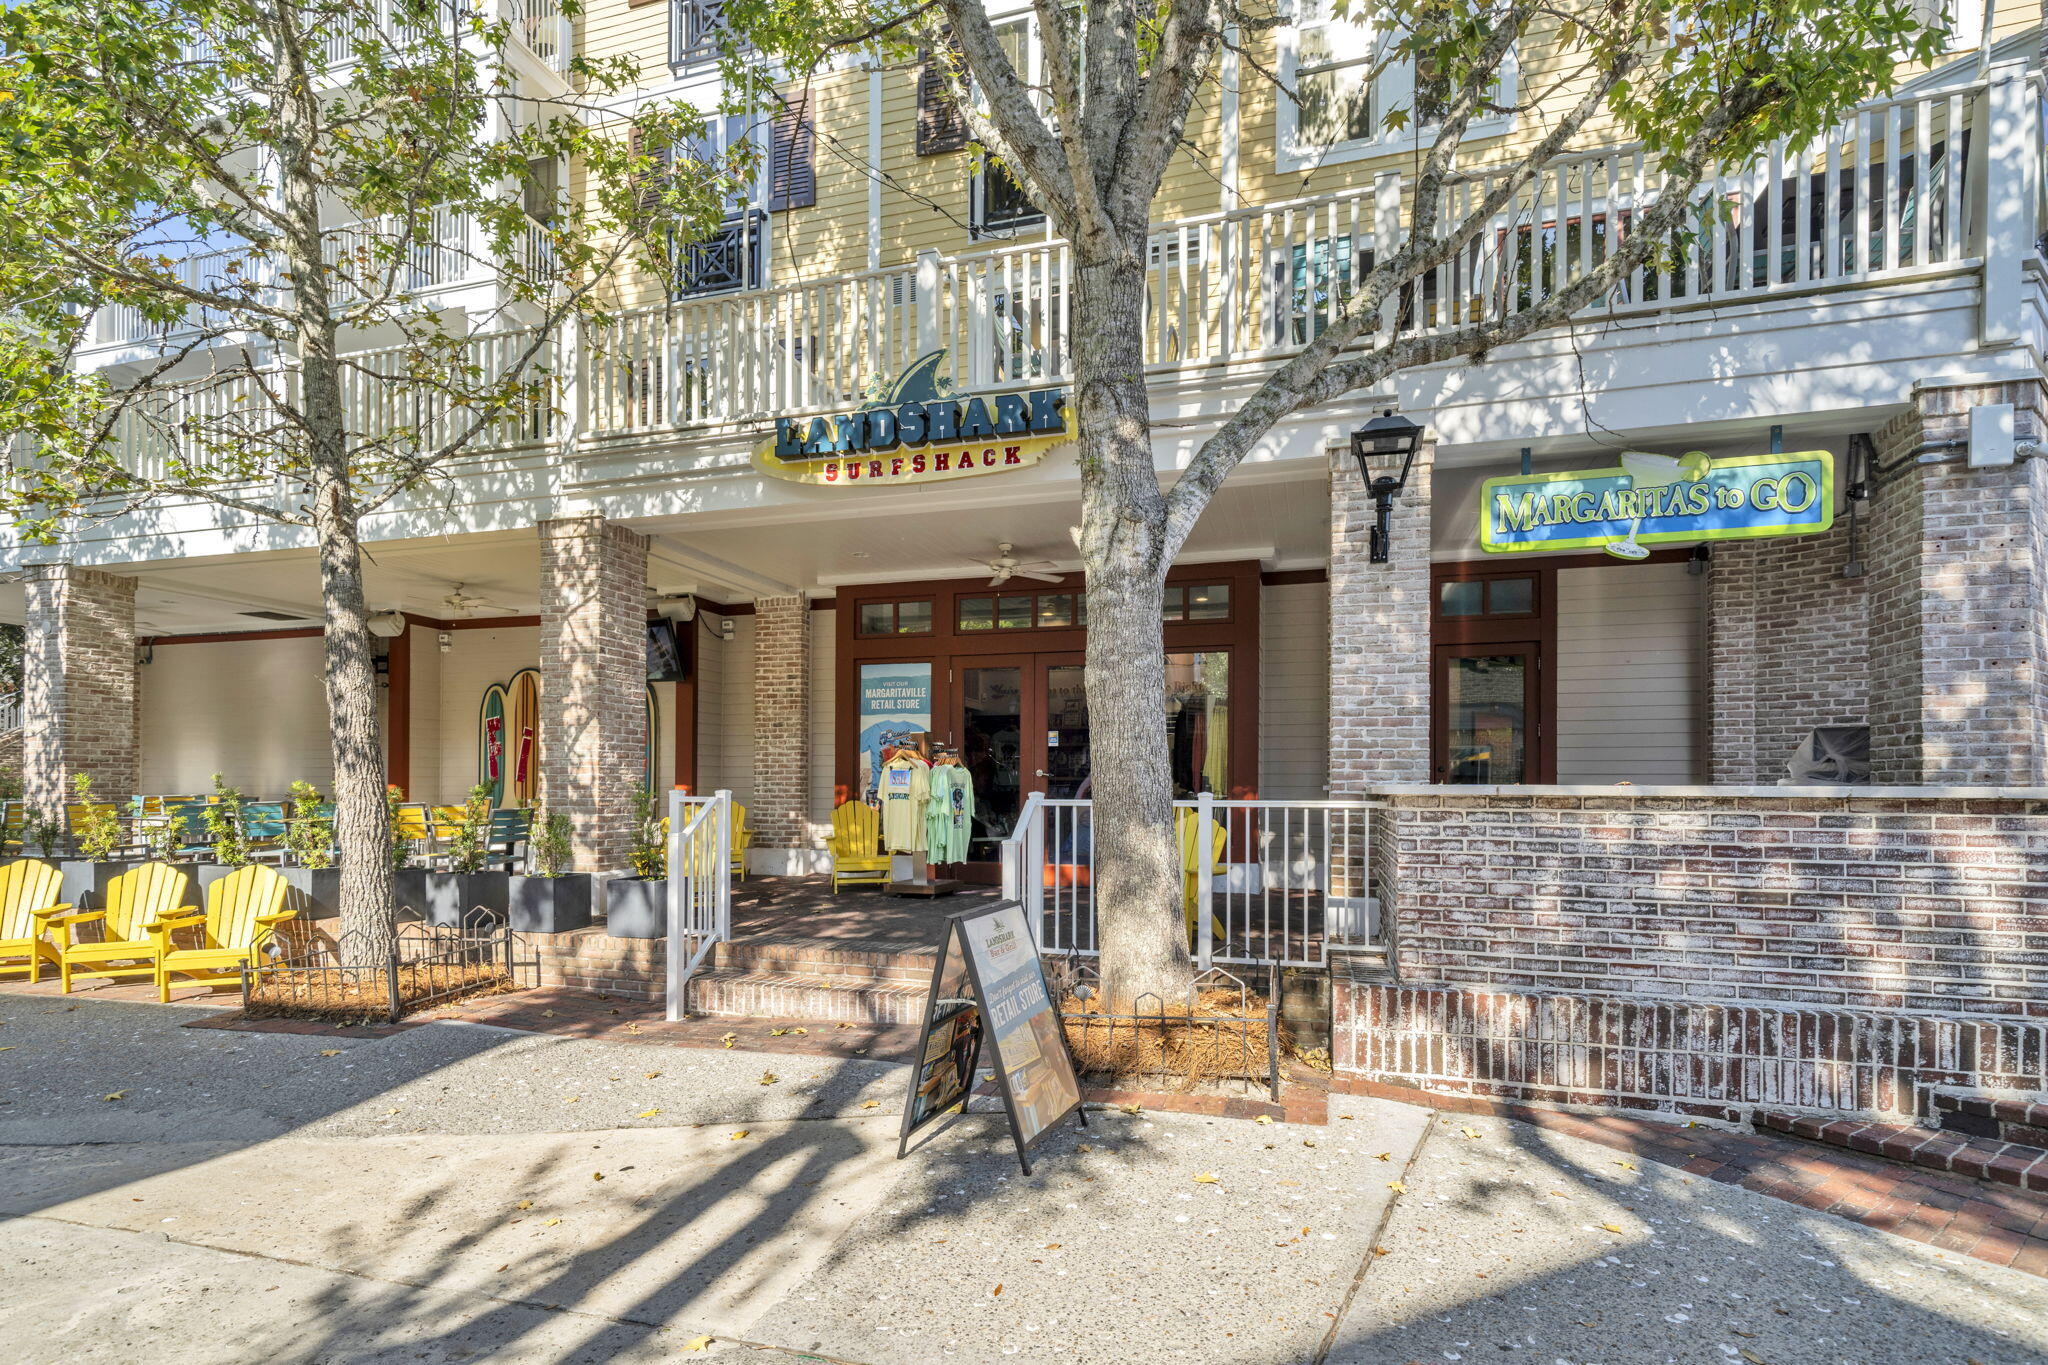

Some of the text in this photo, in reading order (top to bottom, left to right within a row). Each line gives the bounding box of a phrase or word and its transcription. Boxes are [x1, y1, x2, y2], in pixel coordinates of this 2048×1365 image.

[775, 388, 1065, 458] LANDSHARK
[825, 446, 1022, 482] SURFSHACK
[1495, 471, 1818, 534] MARGARITAS to GO
[865, 687, 927, 698] MARGARITAVILLE
[871, 699, 920, 710] RETAIL STORE
[985, 930, 1015, 948] LANDSHARK
[989, 946, 1000, 957] Bar
[990, 980, 1045, 1030] RETAIL STORE
